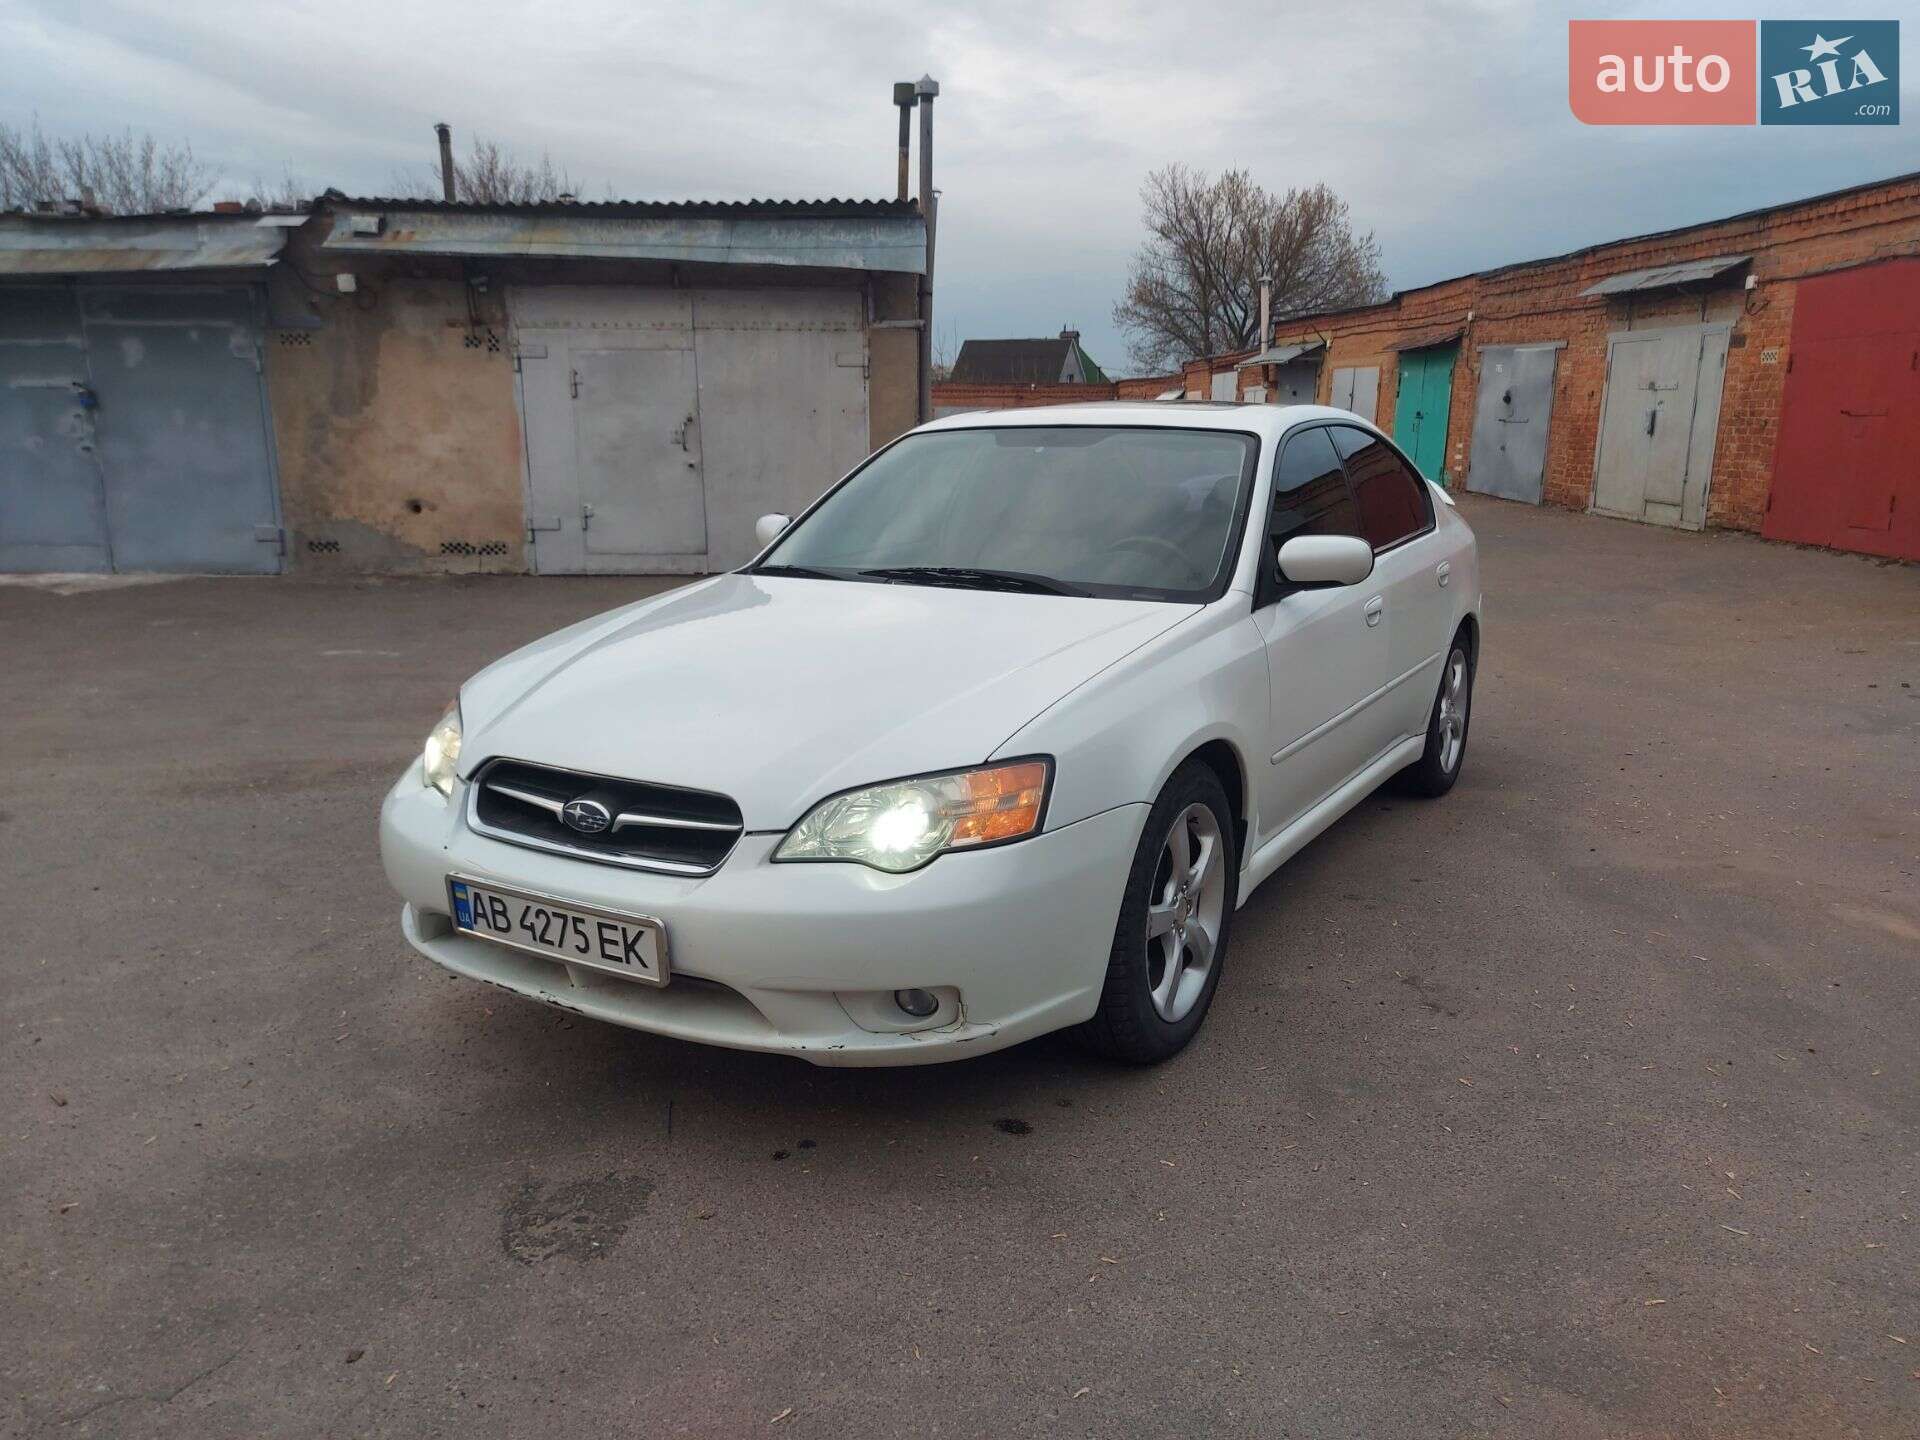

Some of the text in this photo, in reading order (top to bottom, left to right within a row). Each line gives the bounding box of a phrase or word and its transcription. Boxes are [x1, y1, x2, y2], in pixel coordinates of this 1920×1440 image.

[458, 911, 472, 925] UA
[473, 891, 649, 969] AB 4275 EK
